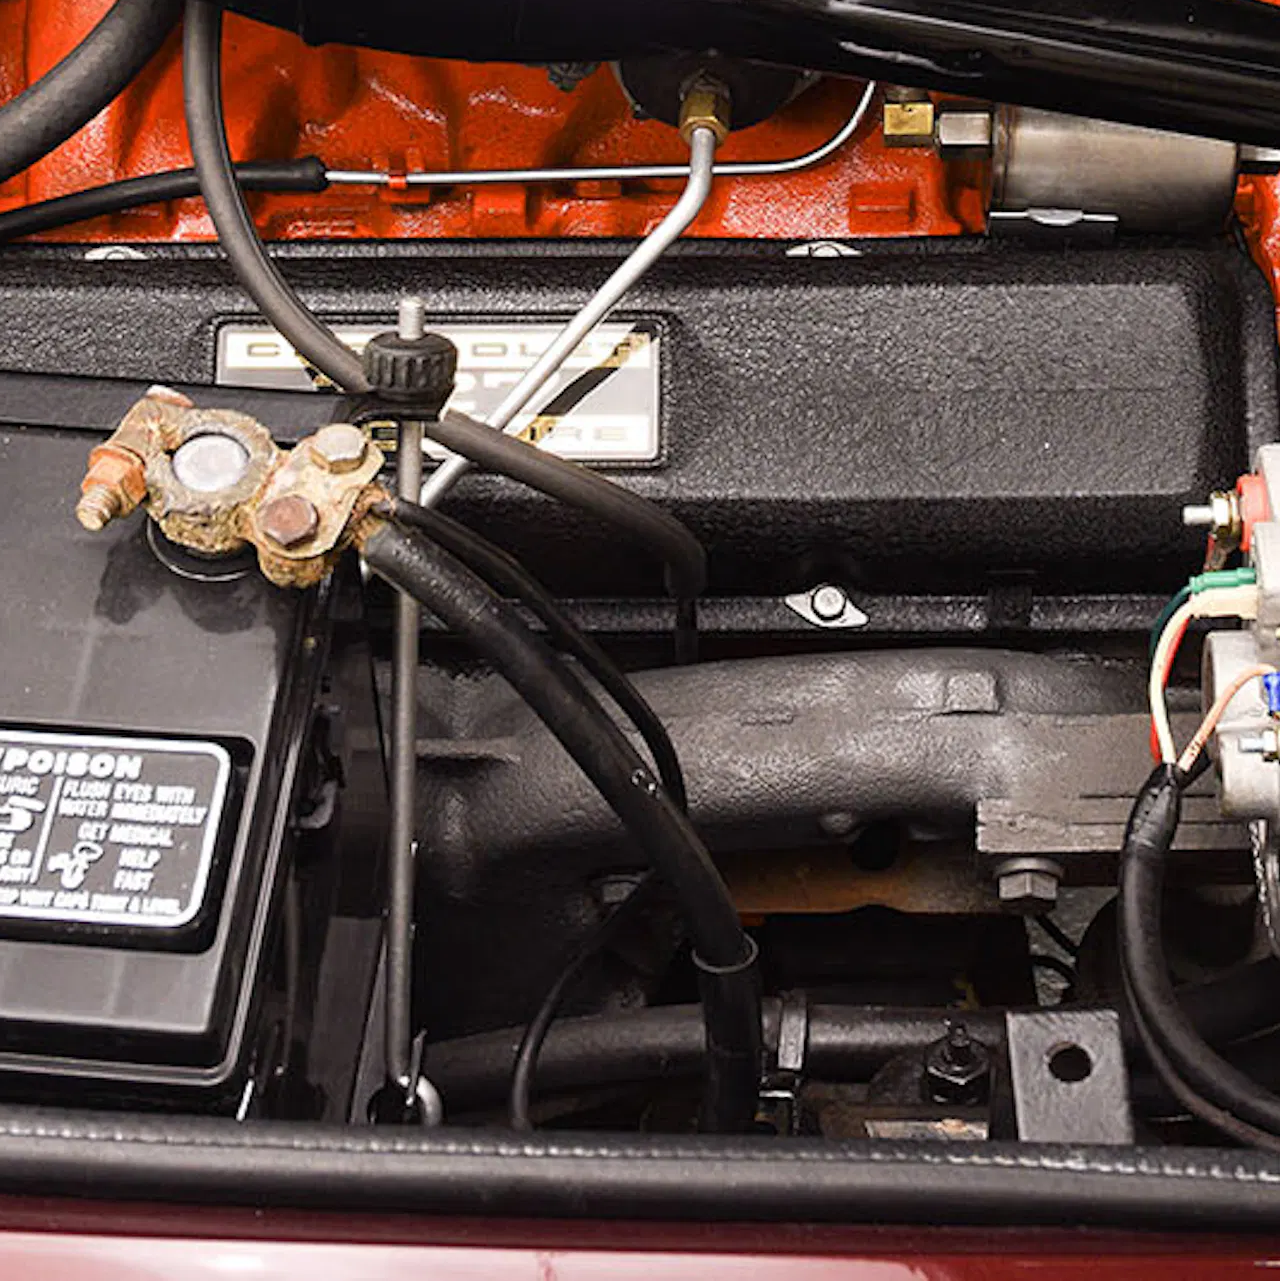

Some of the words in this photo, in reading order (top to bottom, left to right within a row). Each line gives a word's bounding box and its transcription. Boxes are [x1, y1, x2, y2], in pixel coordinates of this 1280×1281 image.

[62, 779, 111, 800] FLUSH
[111, 783, 152, 803] EYES
[77, 822, 109, 841] GET
[111, 869, 152, 892] FAST
